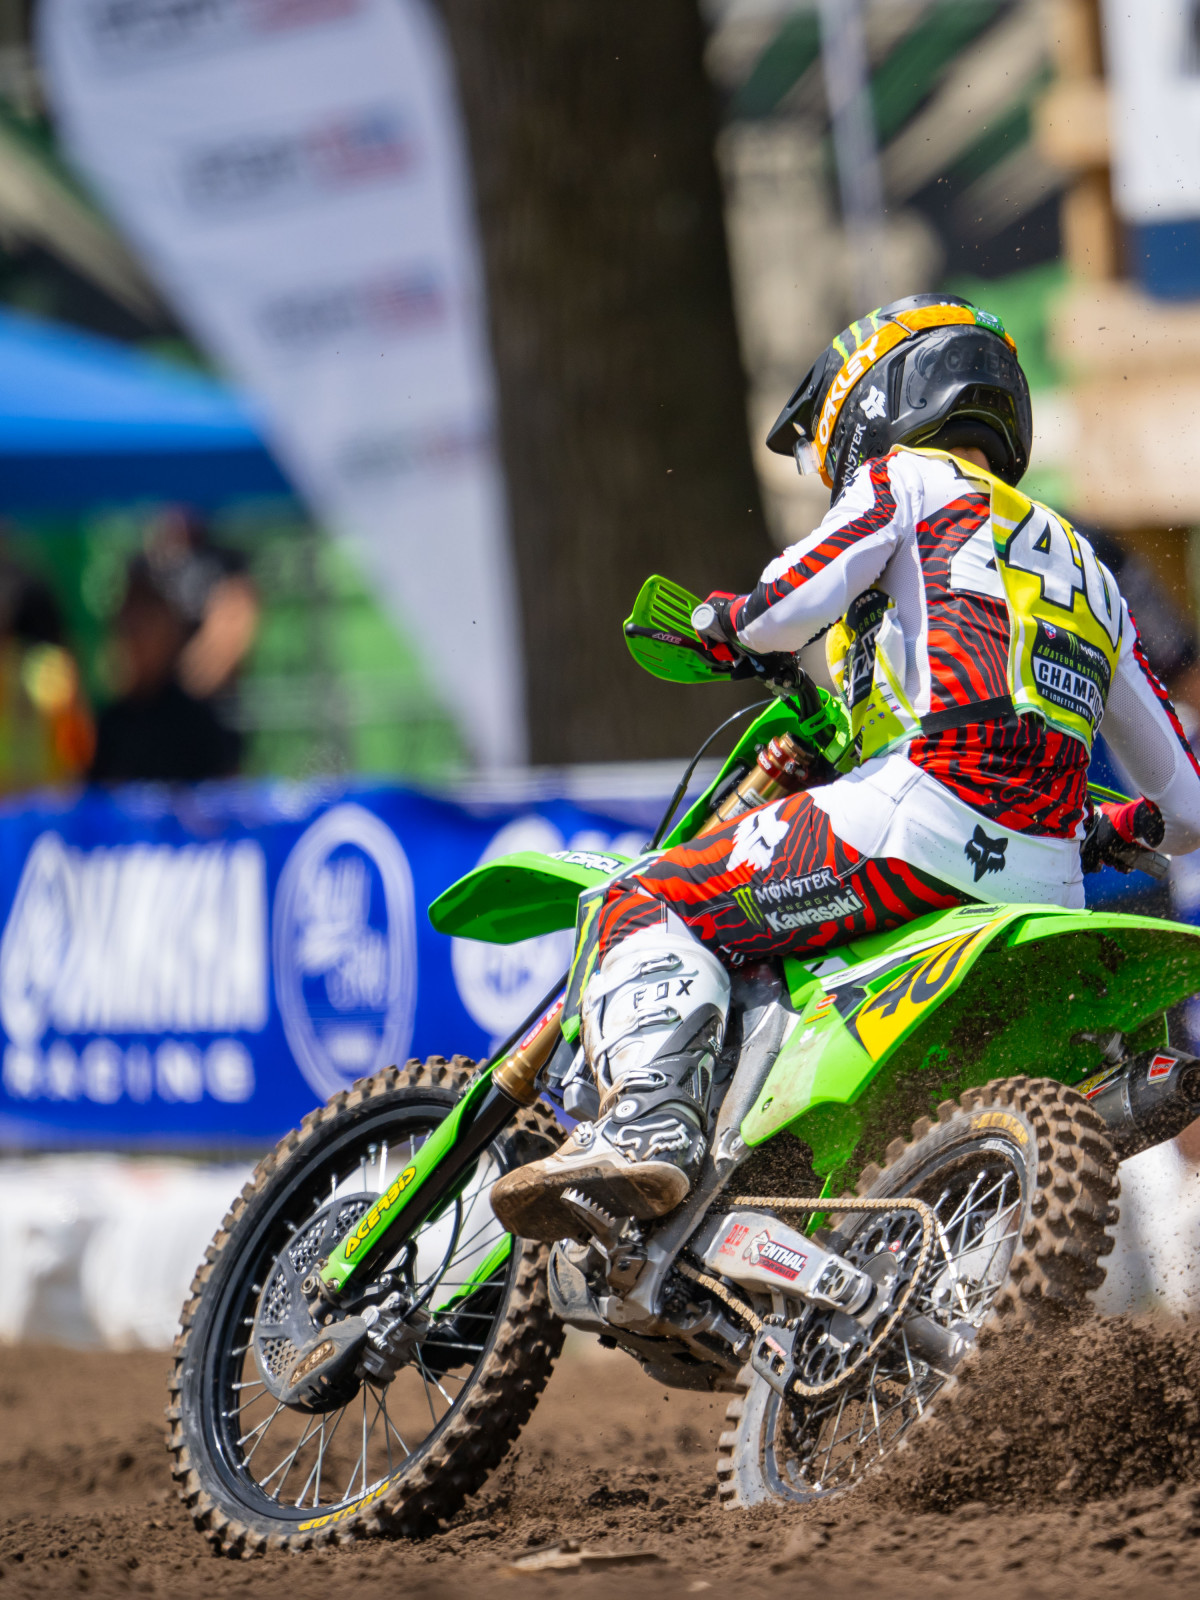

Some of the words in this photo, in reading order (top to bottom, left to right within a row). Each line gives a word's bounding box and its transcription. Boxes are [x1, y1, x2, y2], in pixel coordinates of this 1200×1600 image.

[818, 334, 880, 446] OAKLEY
[1006, 501, 1122, 652] 40
[1036, 644, 1075, 668] AMATEUR
[1049, 691, 1075, 711] LORETTA
[754, 869, 838, 905] MONSTER
[776, 894, 831, 913] ENERGY
[764, 889, 863, 932] Kawasaki
[860, 926, 983, 1019] 40
[633, 979, 694, 1010] FOX
